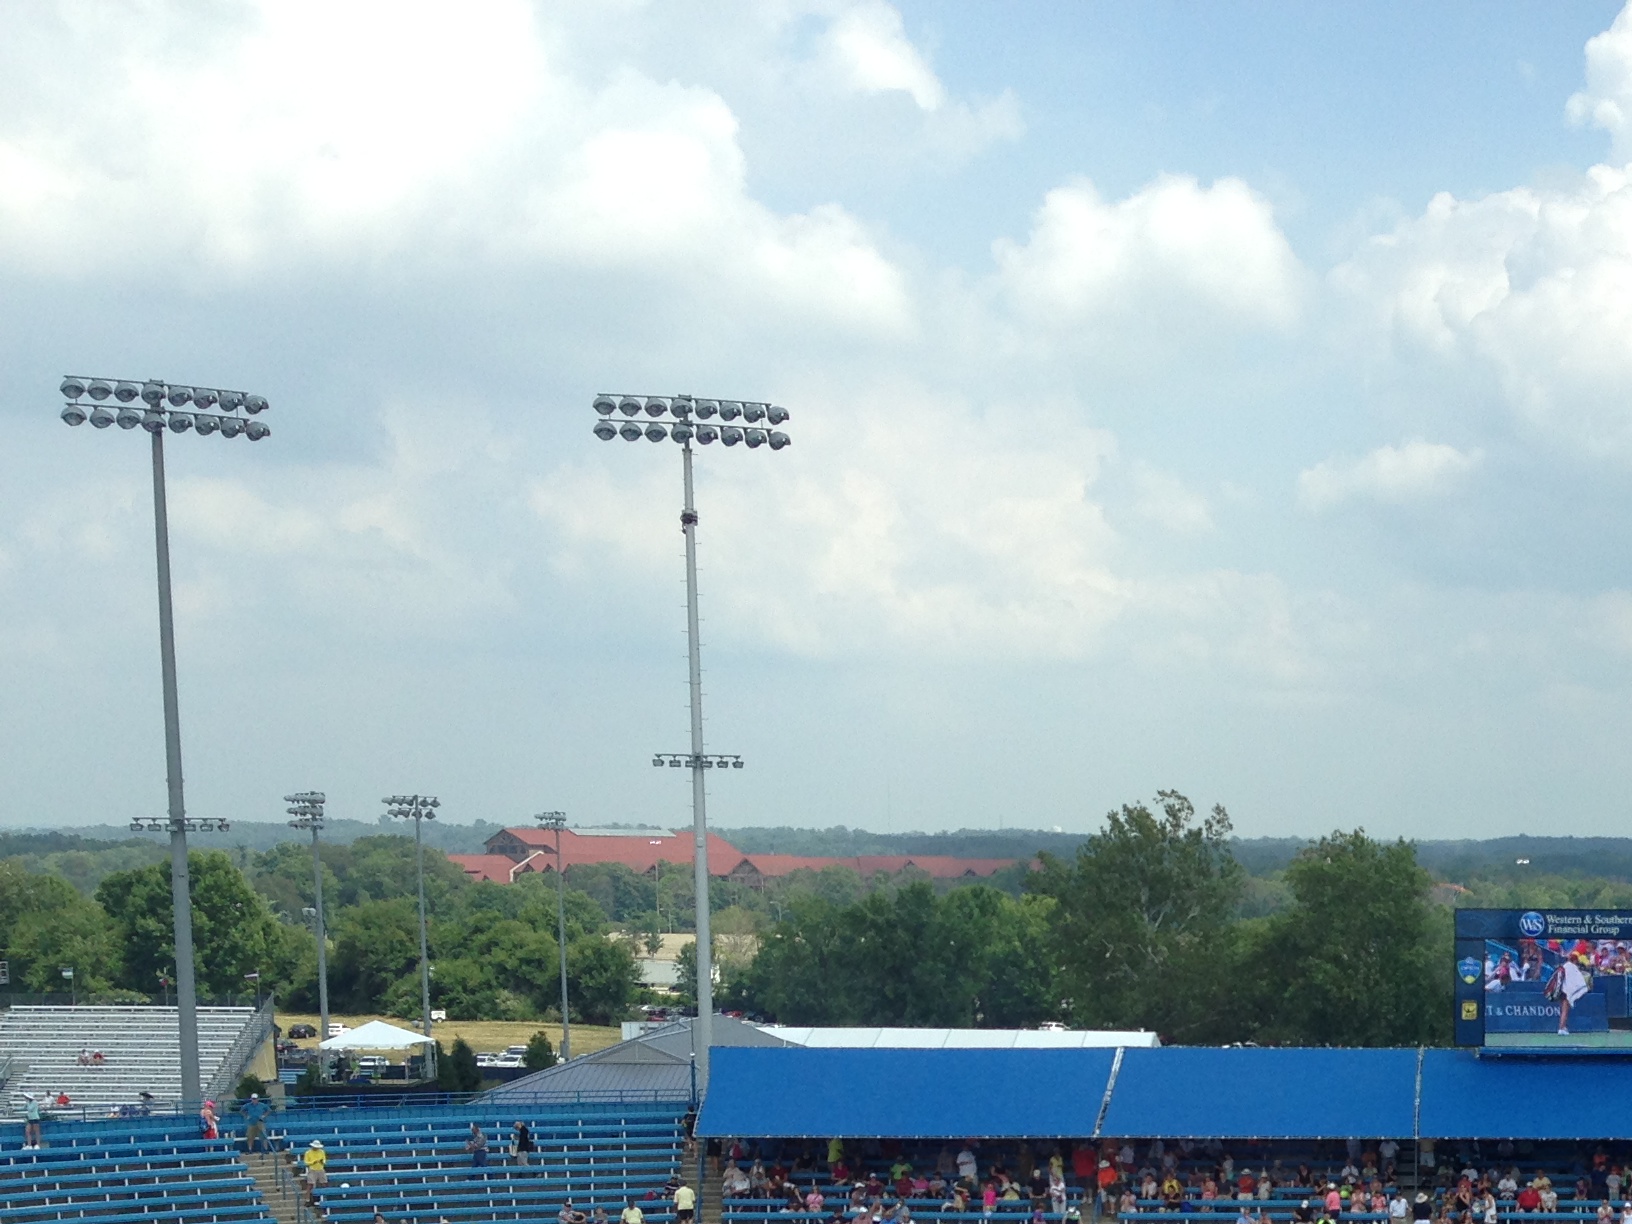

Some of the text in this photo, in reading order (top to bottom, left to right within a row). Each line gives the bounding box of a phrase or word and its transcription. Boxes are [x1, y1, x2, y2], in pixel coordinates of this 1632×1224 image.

[1546, 914, 1582, 924] Western
[1583, 914, 1593, 924] &
[1547, 924, 1620, 936] Financial Group
[1505, 1005, 1561, 1016] CHANDON
